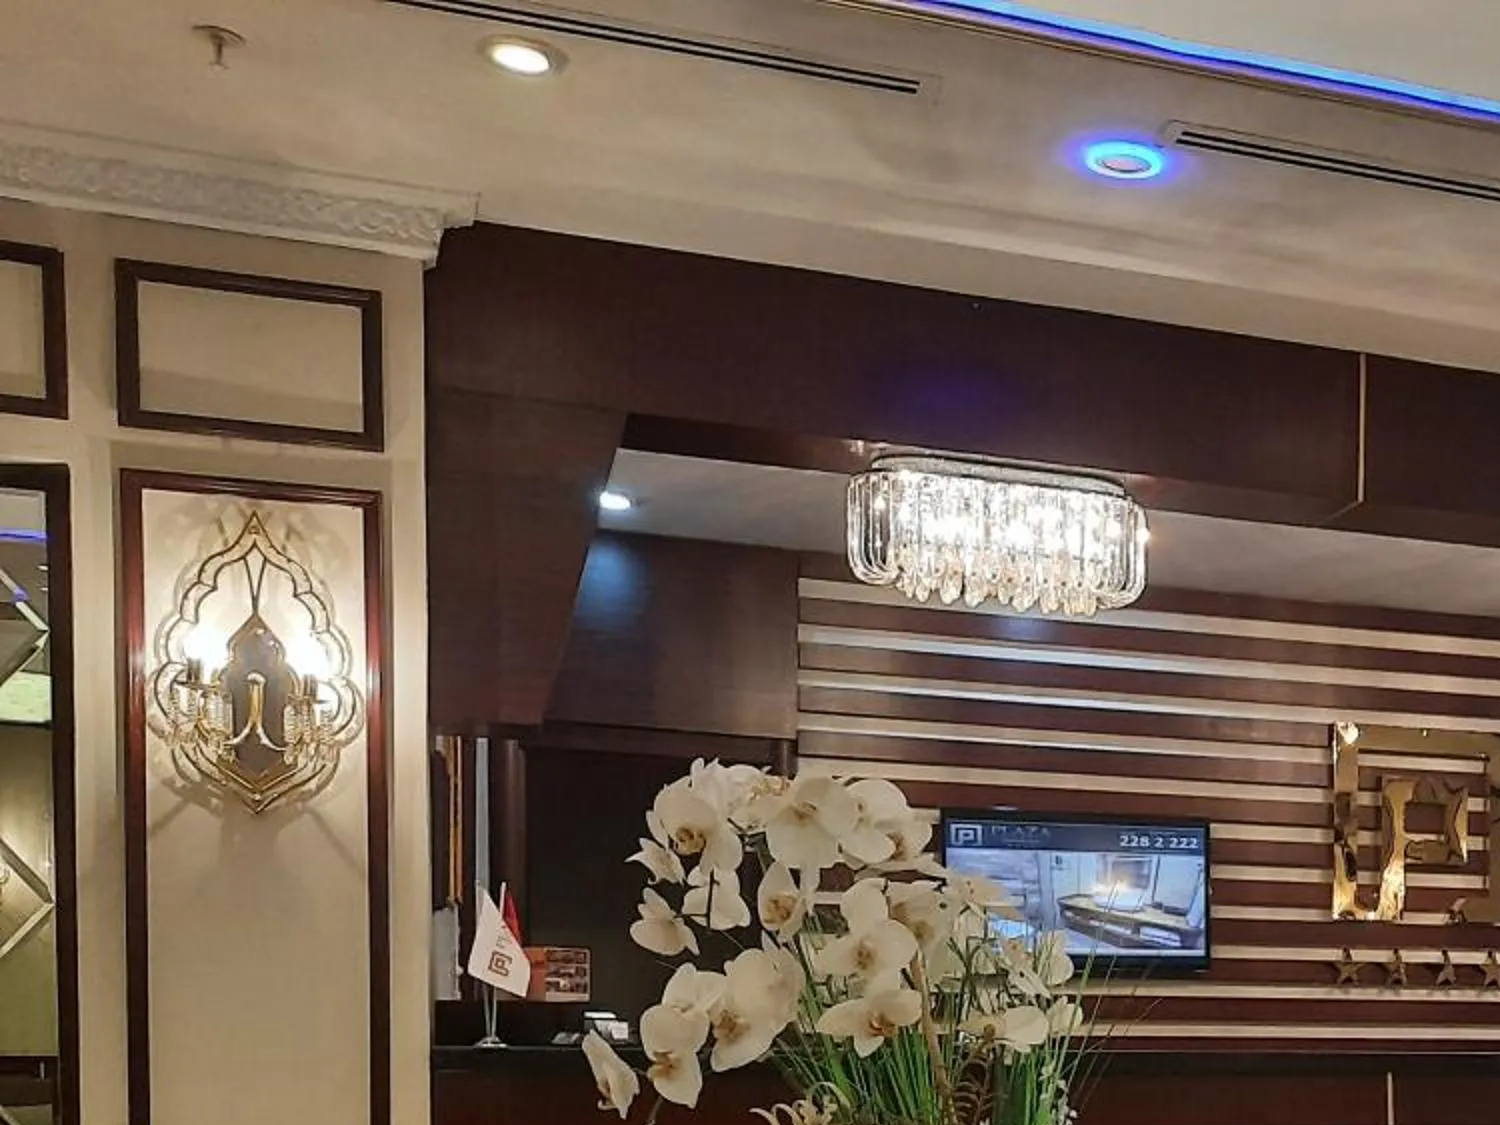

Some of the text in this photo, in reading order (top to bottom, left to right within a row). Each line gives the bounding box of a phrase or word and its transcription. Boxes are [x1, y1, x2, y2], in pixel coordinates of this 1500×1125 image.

[1119, 835, 1199, 849] 228 2 222
